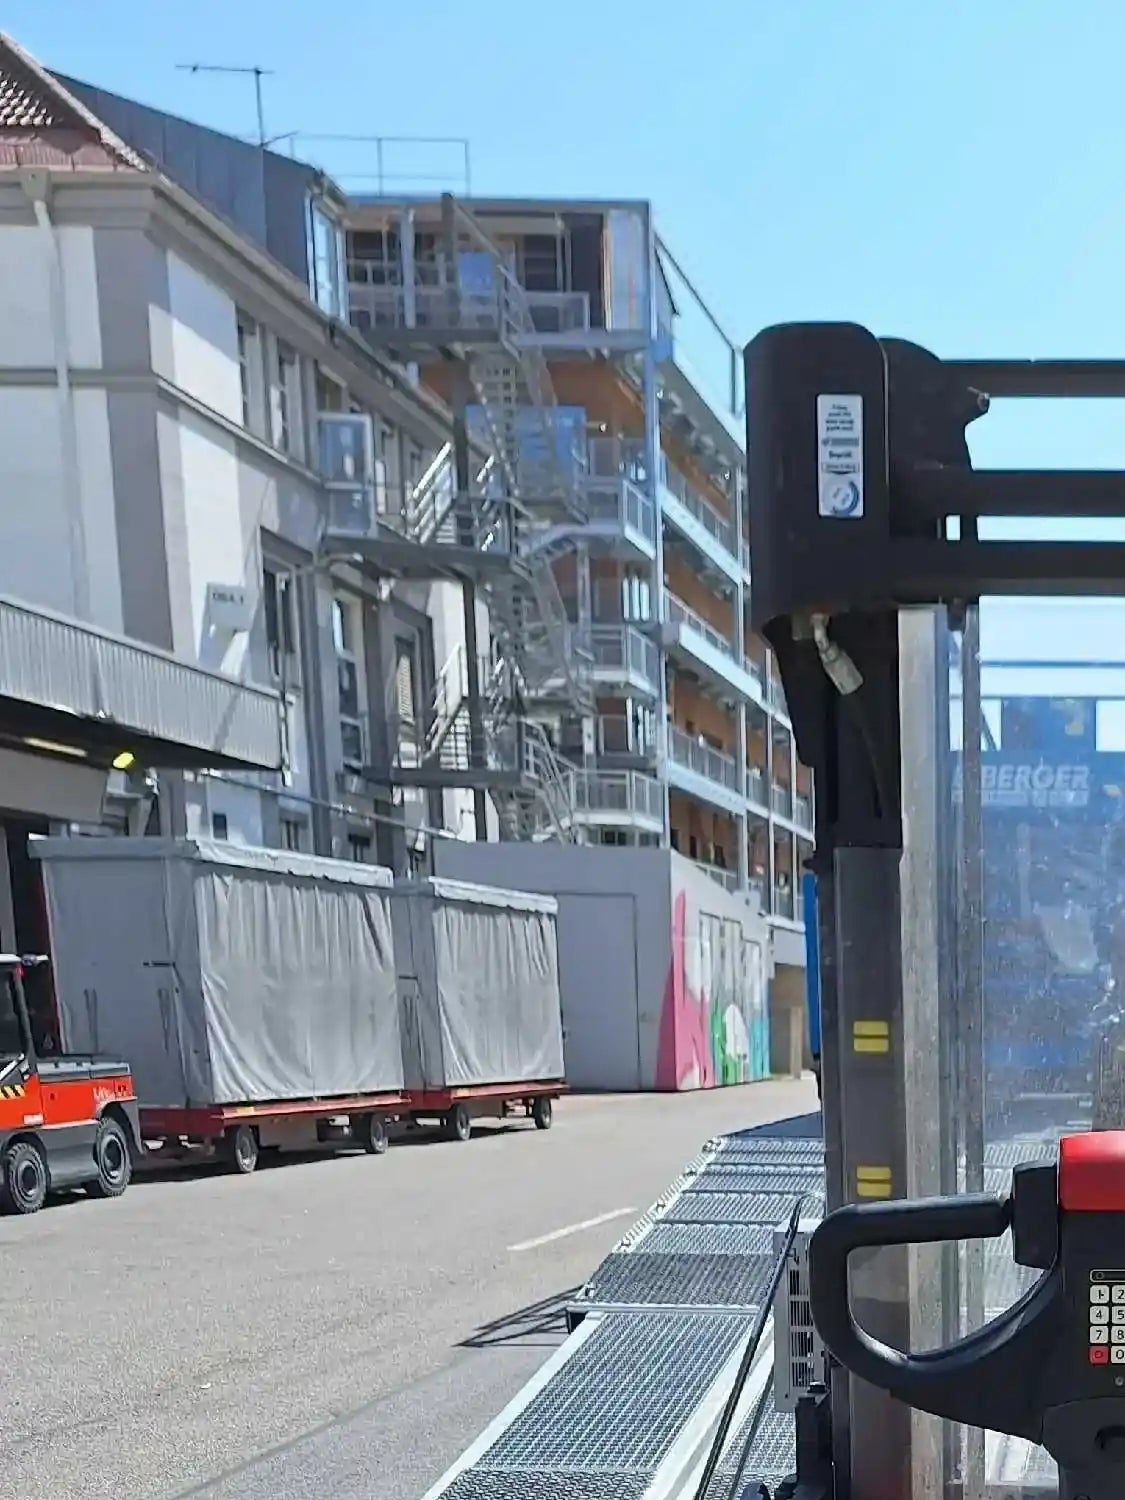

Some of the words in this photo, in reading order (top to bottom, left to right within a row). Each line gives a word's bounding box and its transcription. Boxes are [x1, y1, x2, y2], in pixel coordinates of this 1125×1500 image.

[1117, 1289, 1125, 1300] 2
[1095, 1310, 1103, 1320] 4
[1117, 1310, 1125, 1320] 5
[1096, 1330, 1103, 1340] 7
[1117, 1330, 1125, 1340] 8
[1116, 1350, 1125, 1360] 0
